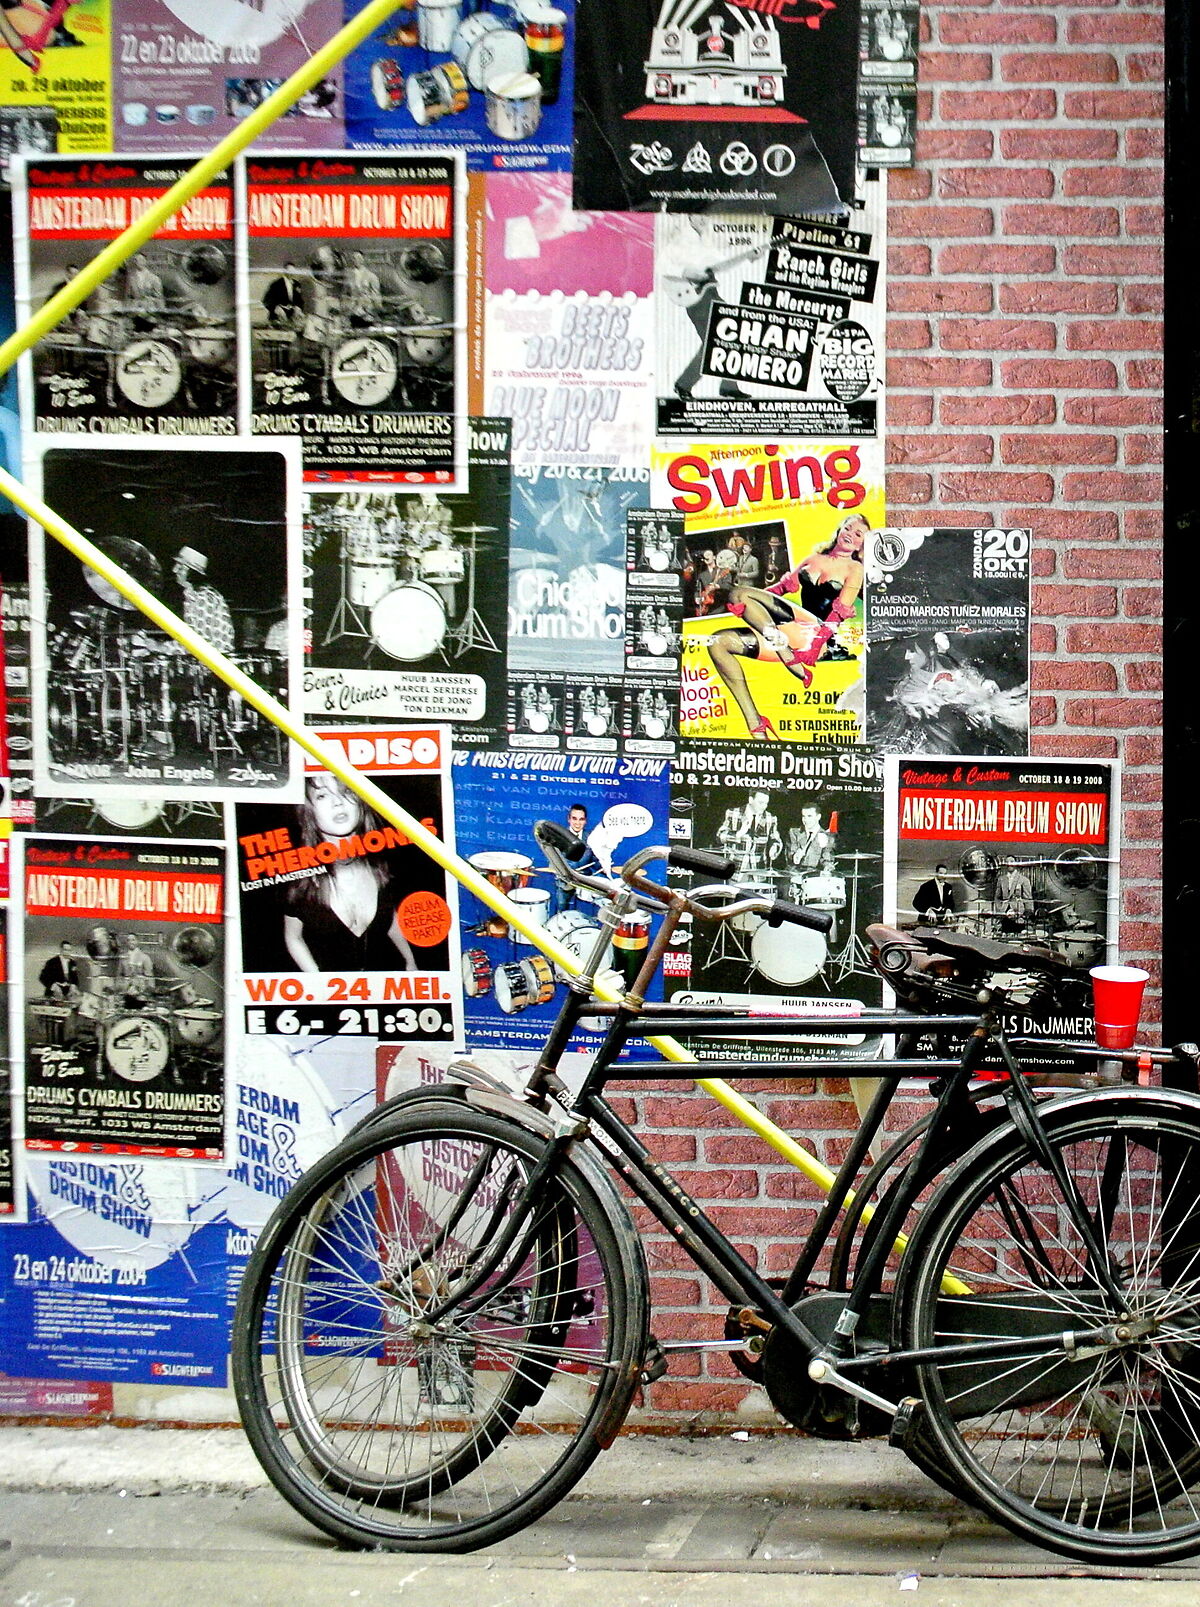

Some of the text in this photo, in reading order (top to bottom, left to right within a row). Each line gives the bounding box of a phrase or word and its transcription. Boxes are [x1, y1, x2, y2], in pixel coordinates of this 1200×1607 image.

[249, 193, 448, 230] AMSTERDAM DRUM SHOW
[783, 222, 836, 246] Pipeline
[777, 249, 867, 283] Ranch Girls
[749, 287, 843, 321] the Mercurys
[716, 318, 809, 353] CHAN
[825, 339, 874, 354] BIG
[710, 347, 802, 385] ROMERO
[820, 355, 874, 369] RECORD
[821, 369, 875, 380] MARKET
[686, 401, 847, 414] EINDHOVEN, KARREGATHALL
[710, 446, 763, 461] Afternoon
[667, 445, 866, 513] Swing
[984, 530, 1028, 558] 20
[973, 530, 982, 578] ZONDAG
[983, 559, 1028, 571] OKT
[871, 596, 918, 604] FLAMENCO:
[871, 606, 908, 616] CUADRO
[910, 606, 949, 616] MARCOS
[982, 607, 1026, 617] MORALES
[395, 685, 478, 694] MARCEL SERIERSE
[124, 766, 214, 780] John Engels
[781, 753, 833, 775] Drum
[703, 775, 823, 791] 21 Oktober 2007
[902, 766, 1011, 785] Vintage & Custom
[1019, 774, 1102, 784] OCTOBER 18 & 19 2008
[902, 798, 1102, 835] AMSTERDAM DRUM SHOW
[239, 828, 292, 858] THE
[275, 866, 327, 884] AMSTERDAM
[404, 900, 441, 915] ALBUM
[404, 911, 445, 928] RELEASE
[412, 925, 442, 937] PARTY
[244, 977, 451, 1002] WO. 24 MEI.
[339, 1008, 452, 1033] 21:30.
[14, 1255, 146, 1285] 23 en 24 oktober 2004
